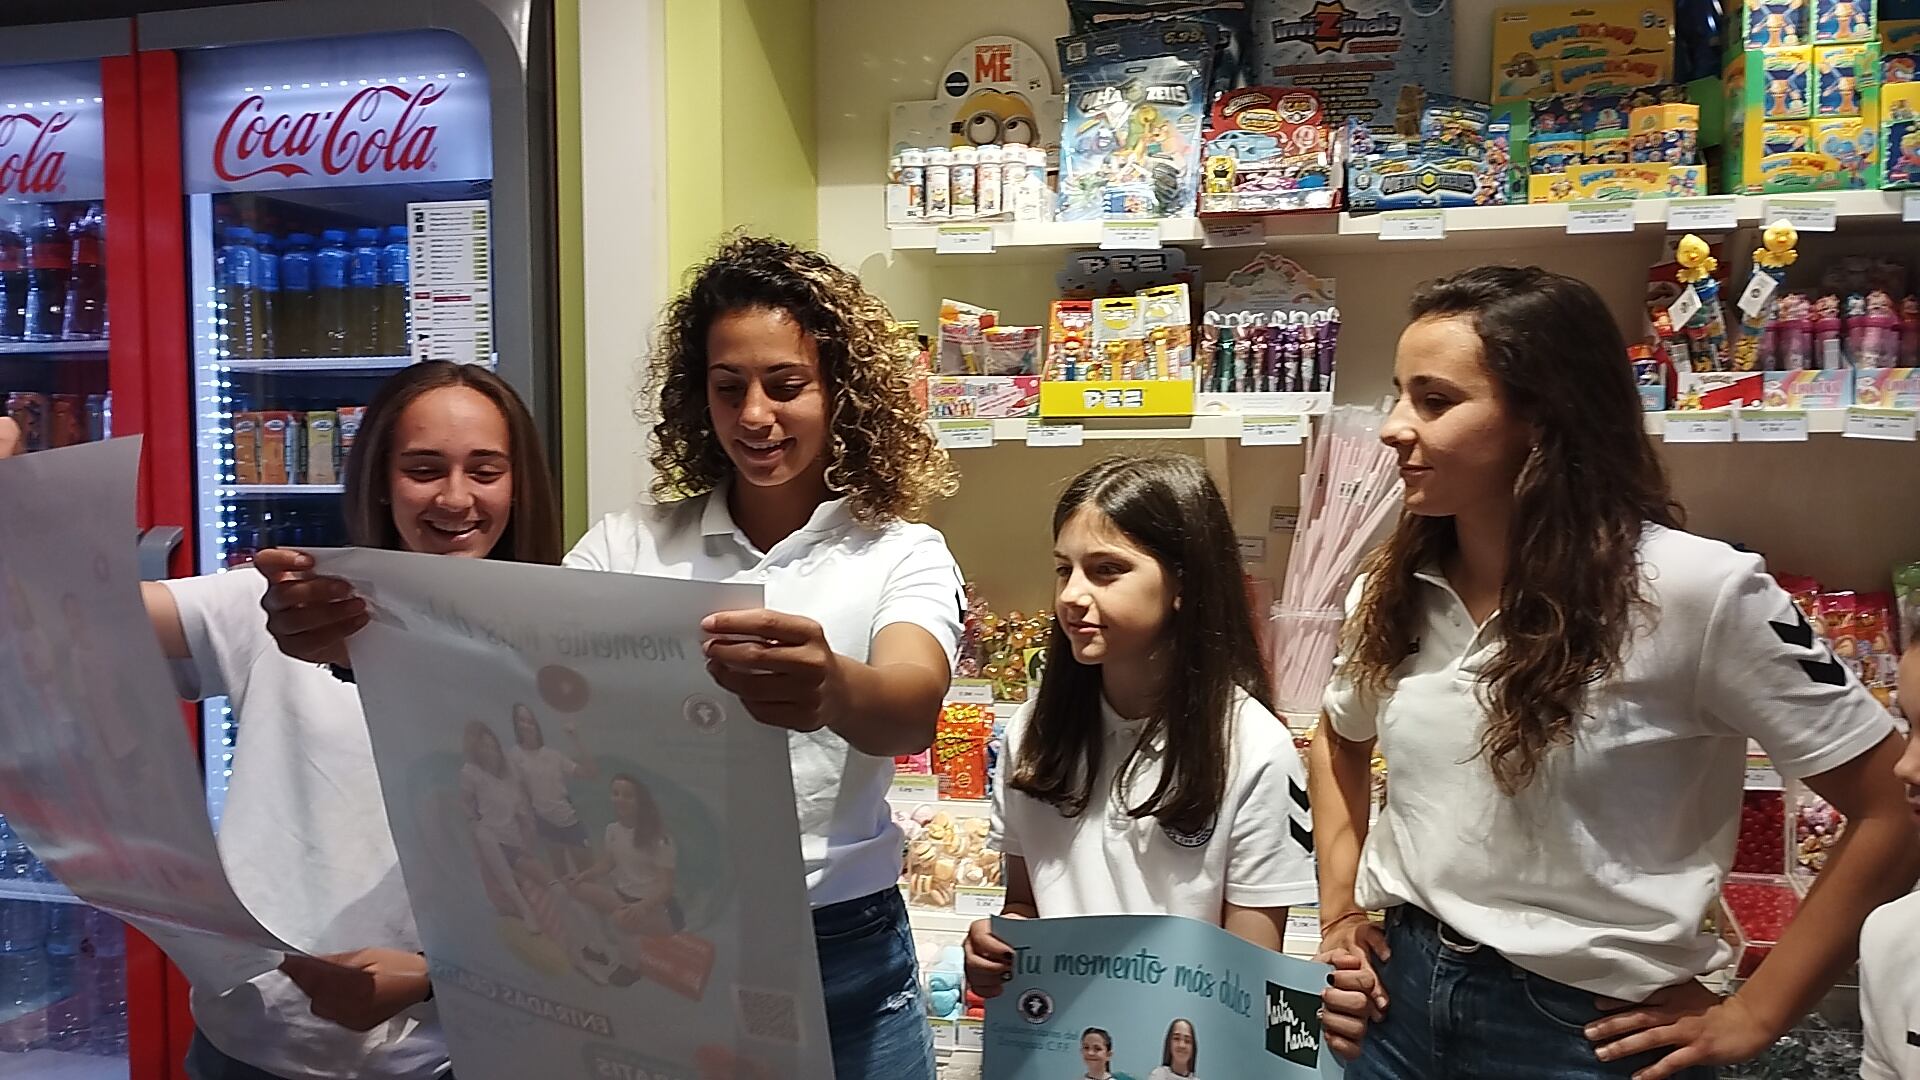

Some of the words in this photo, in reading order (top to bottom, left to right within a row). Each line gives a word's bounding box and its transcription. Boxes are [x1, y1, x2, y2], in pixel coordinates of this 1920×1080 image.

[974, 52, 1012, 83] ME
[213, 82, 449, 182] Coca-Cola
[1077, 253, 1168, 275] PEZ
[1082, 388, 1145, 408] PEZ
[1014, 946, 1041, 975] Tu
[1054, 947, 1168, 985] momento
[1173, 964, 1217, 999] más
[1219, 968, 1251, 1018] dulce
